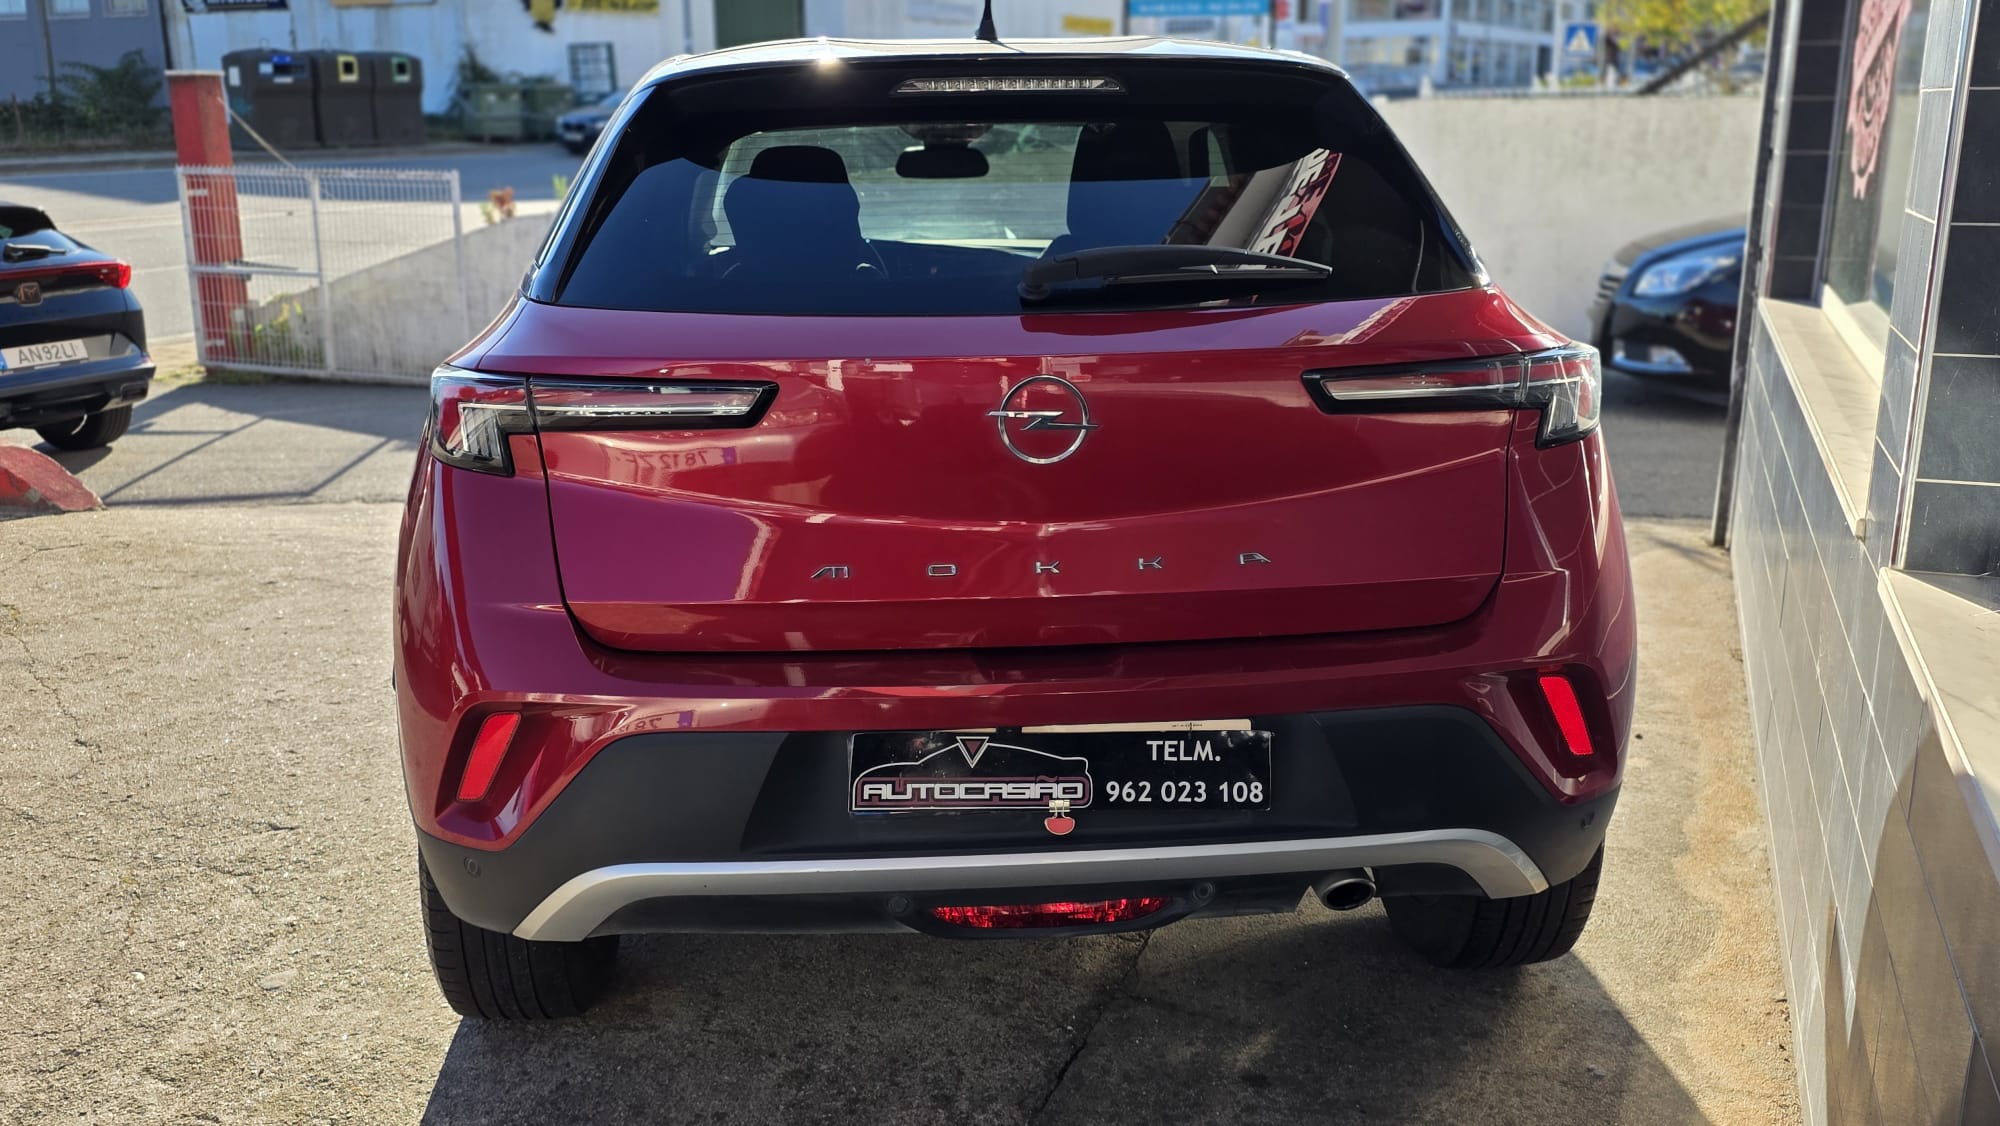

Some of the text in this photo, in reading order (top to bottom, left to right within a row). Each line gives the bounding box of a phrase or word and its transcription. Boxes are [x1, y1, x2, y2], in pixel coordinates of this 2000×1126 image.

[810, 551, 1272, 580] MOKKA
[1146, 740, 1222, 762] TELM.
[863, 777, 1083, 800] AUTOCASIÃO
[1105, 780, 1264, 803] 962 023 108
